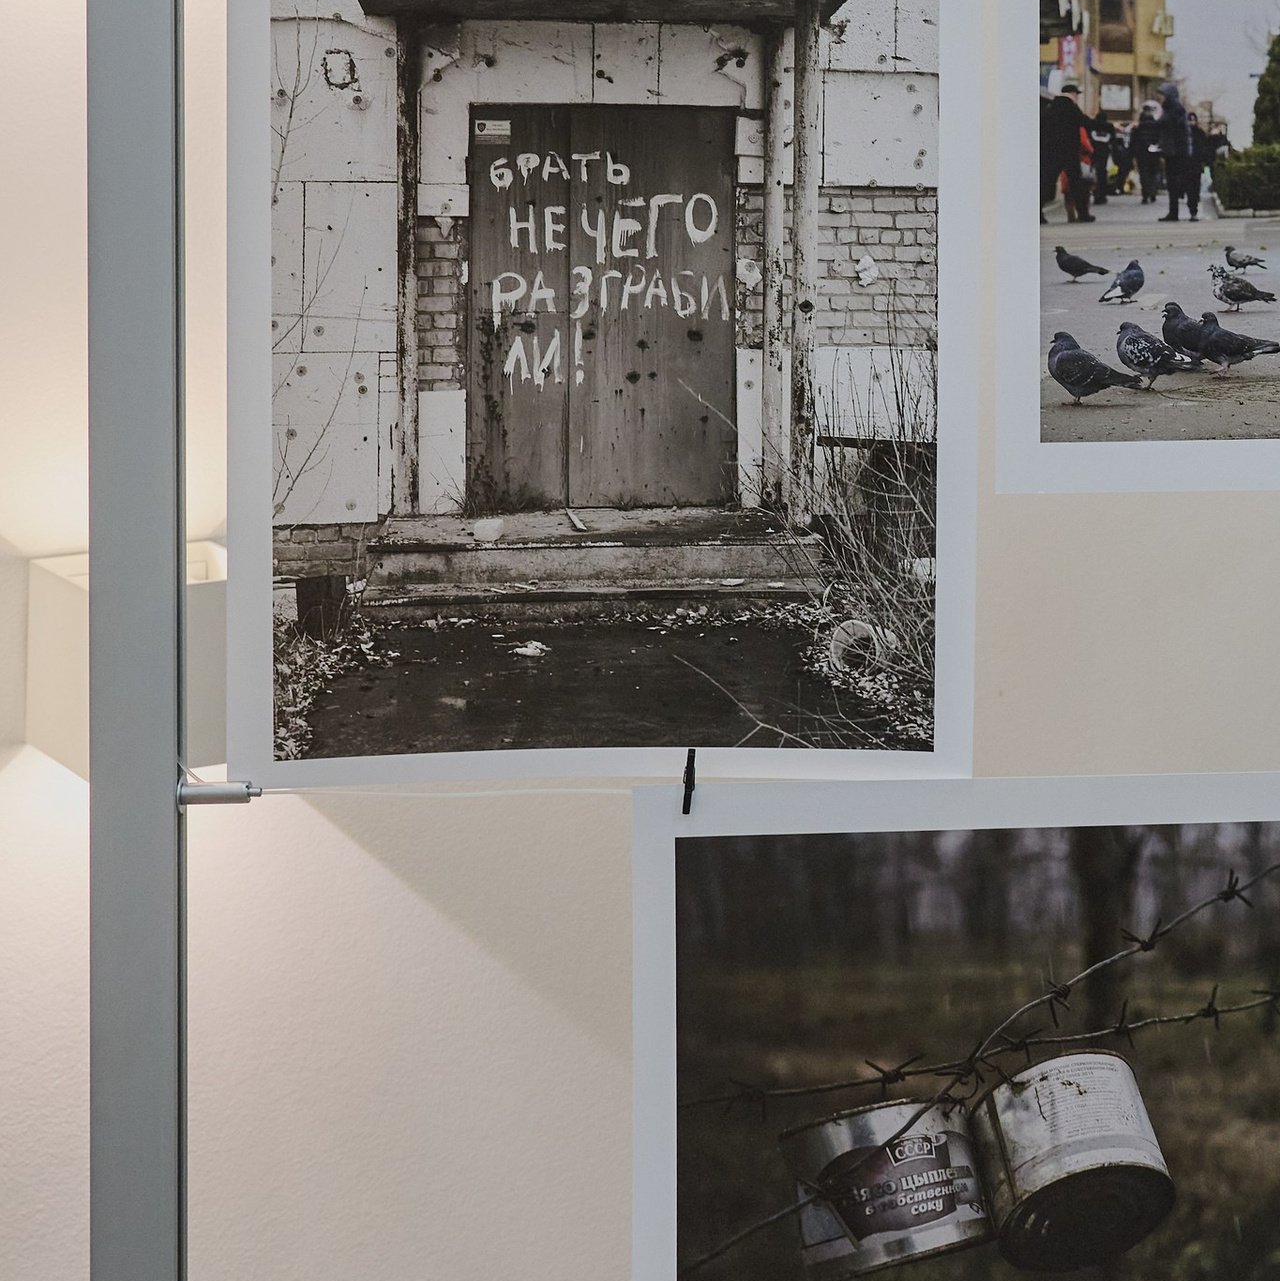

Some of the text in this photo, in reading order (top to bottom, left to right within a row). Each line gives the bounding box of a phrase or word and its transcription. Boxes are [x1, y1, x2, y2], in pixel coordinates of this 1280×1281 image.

[491, 264, 730, 332] РАЗГРАБИ
[503, 320, 585, 396] ЛИ!
[895, 1142, 931, 1160] СССР
[910, 1198, 945, 1216] соку
